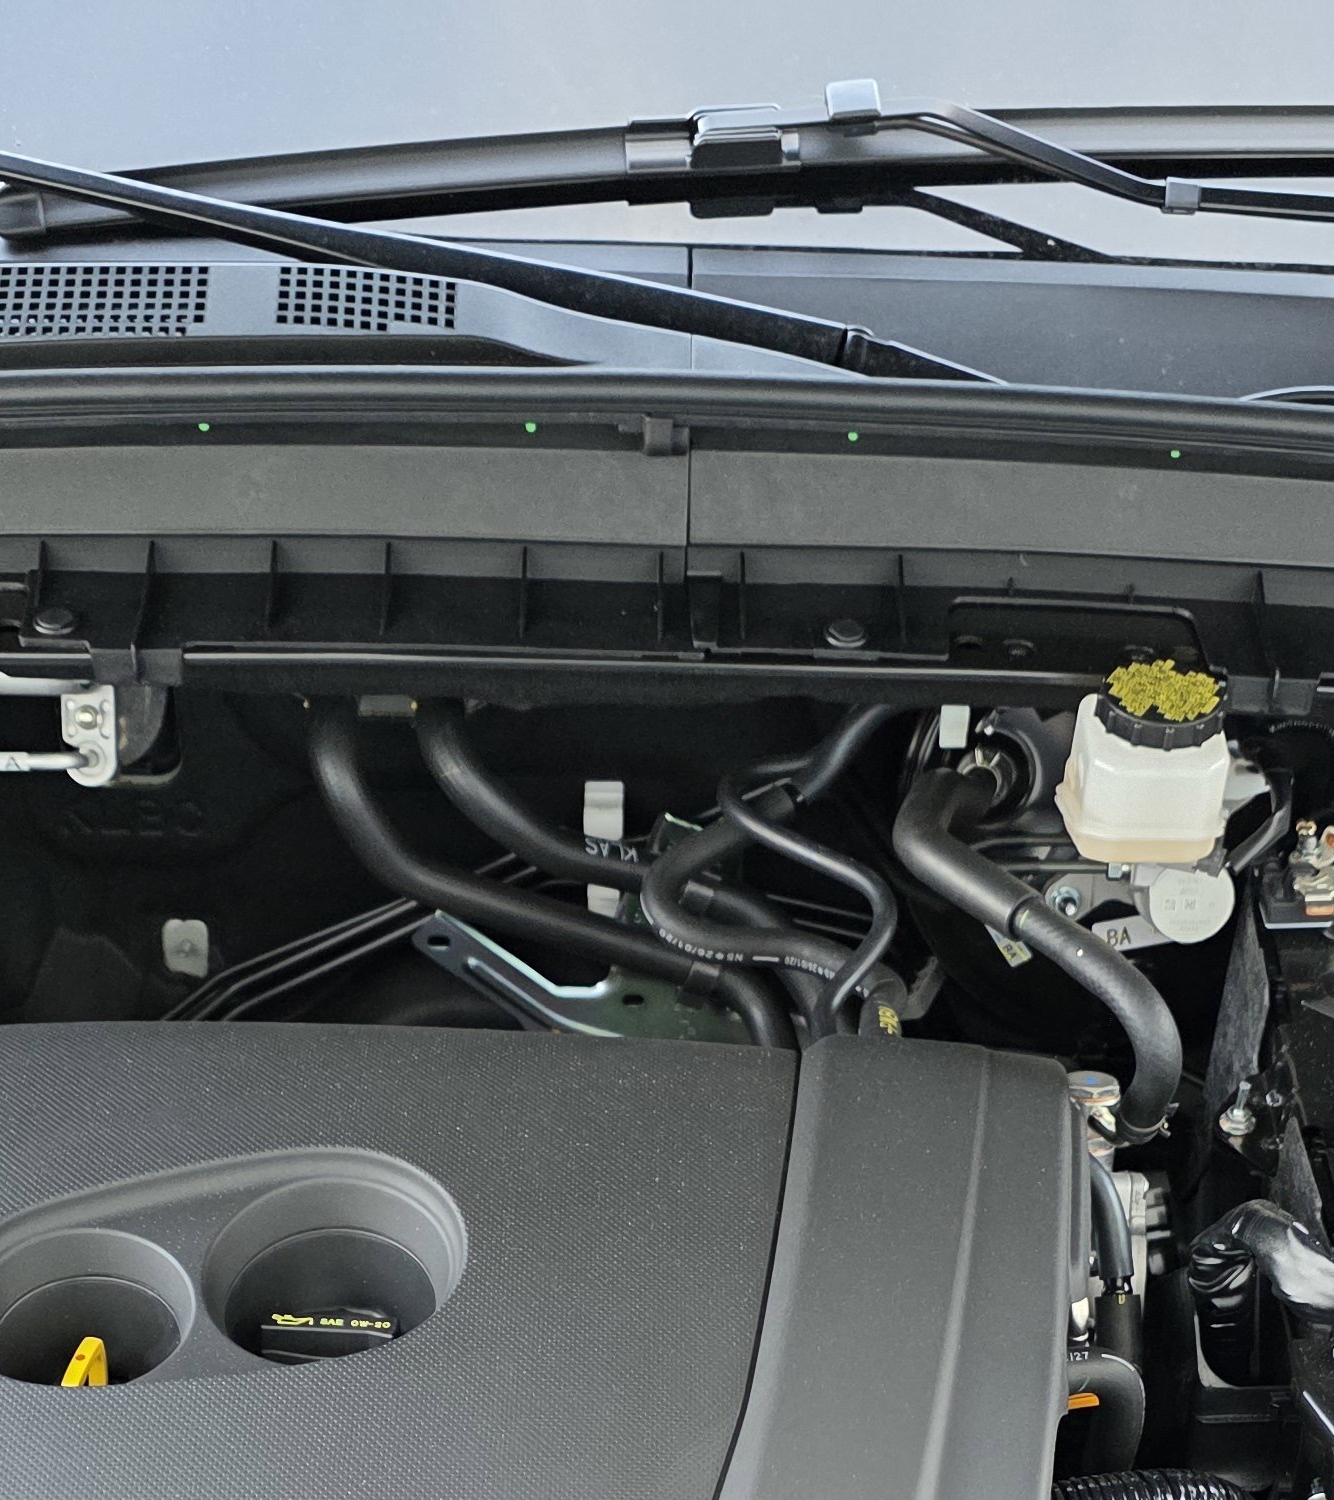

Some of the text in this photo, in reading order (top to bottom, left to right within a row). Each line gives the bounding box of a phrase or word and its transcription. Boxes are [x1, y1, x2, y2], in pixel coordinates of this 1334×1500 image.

[1106, 926, 1132, 947] BA
[319, 1317, 392, 1329] SAE 0W-20
